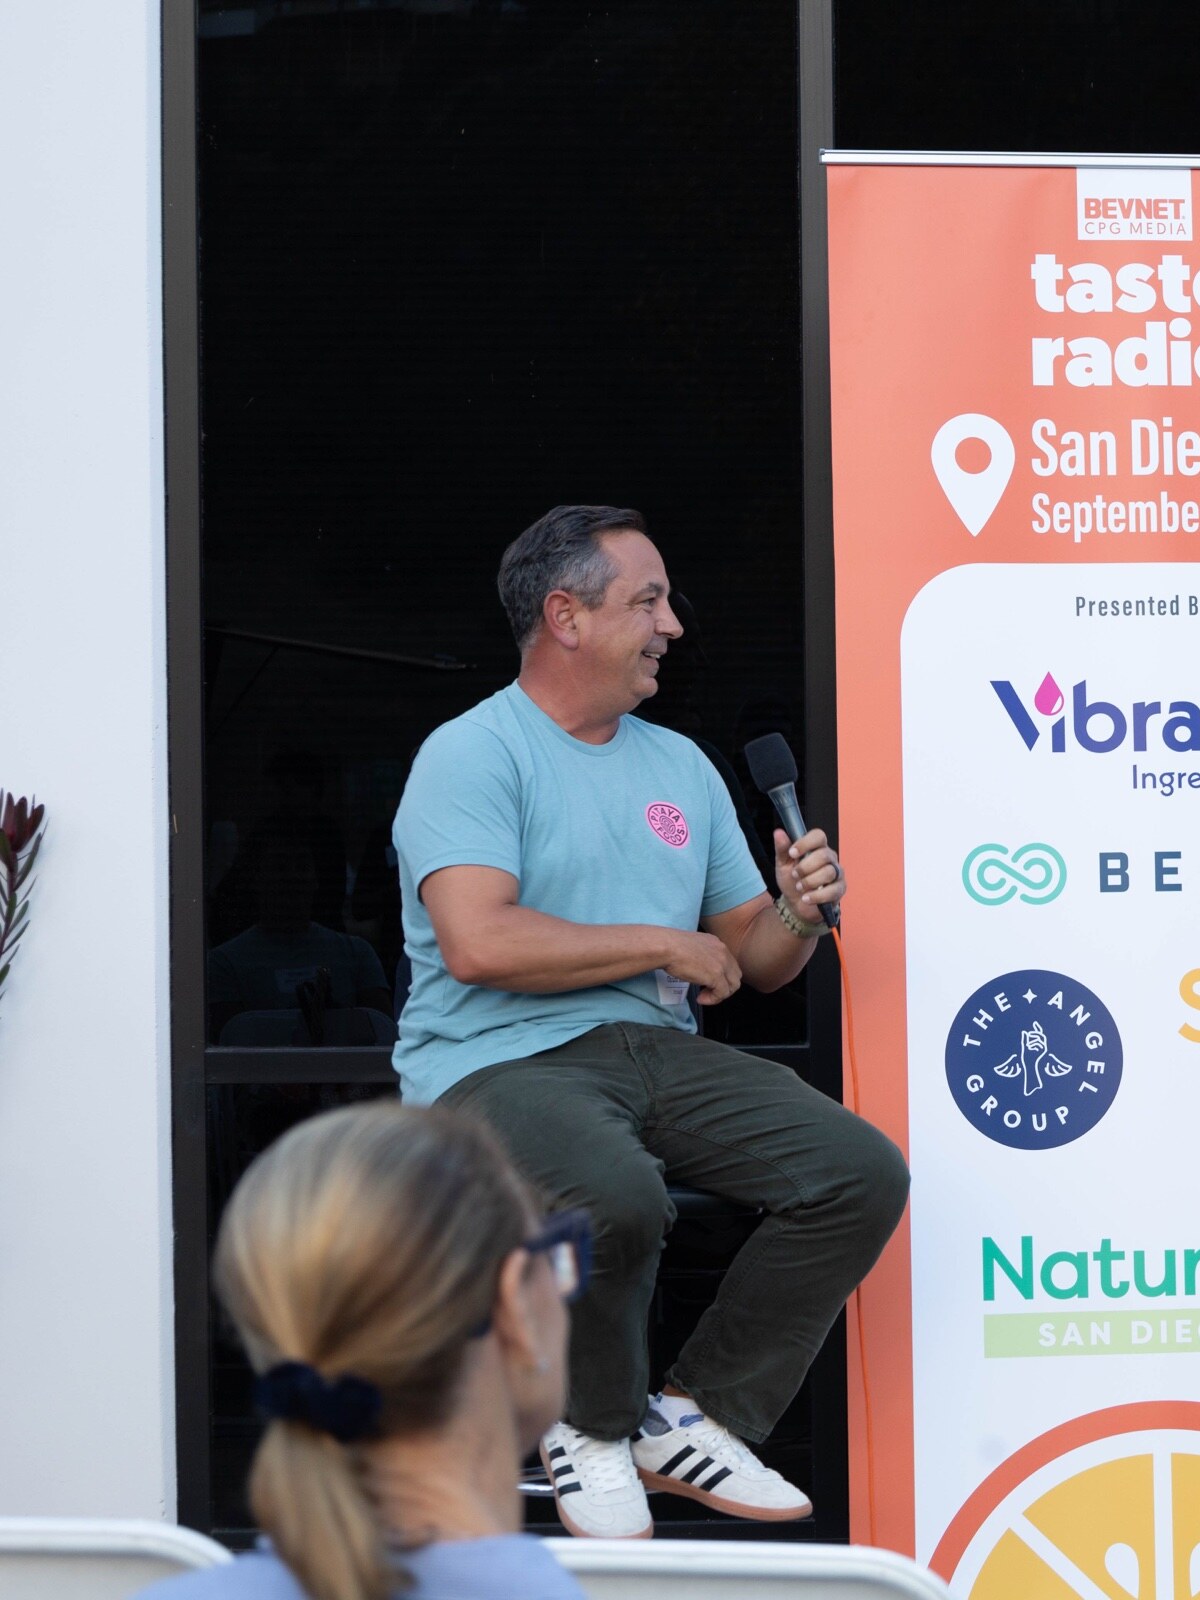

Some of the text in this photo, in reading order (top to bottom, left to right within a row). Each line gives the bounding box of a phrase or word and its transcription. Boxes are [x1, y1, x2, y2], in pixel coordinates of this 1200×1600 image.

[1085, 222, 1186, 235] CPG MEDIA
[1031, 418, 1117, 477] San
[1075, 595, 1180, 618] Presented
[651, 807, 680, 823] PITAYA
[963, 990, 1105, 1094] THE ANGEL
[966, 1074, 1070, 1131] GROUP
[1038, 1321, 1111, 1348] SAN
